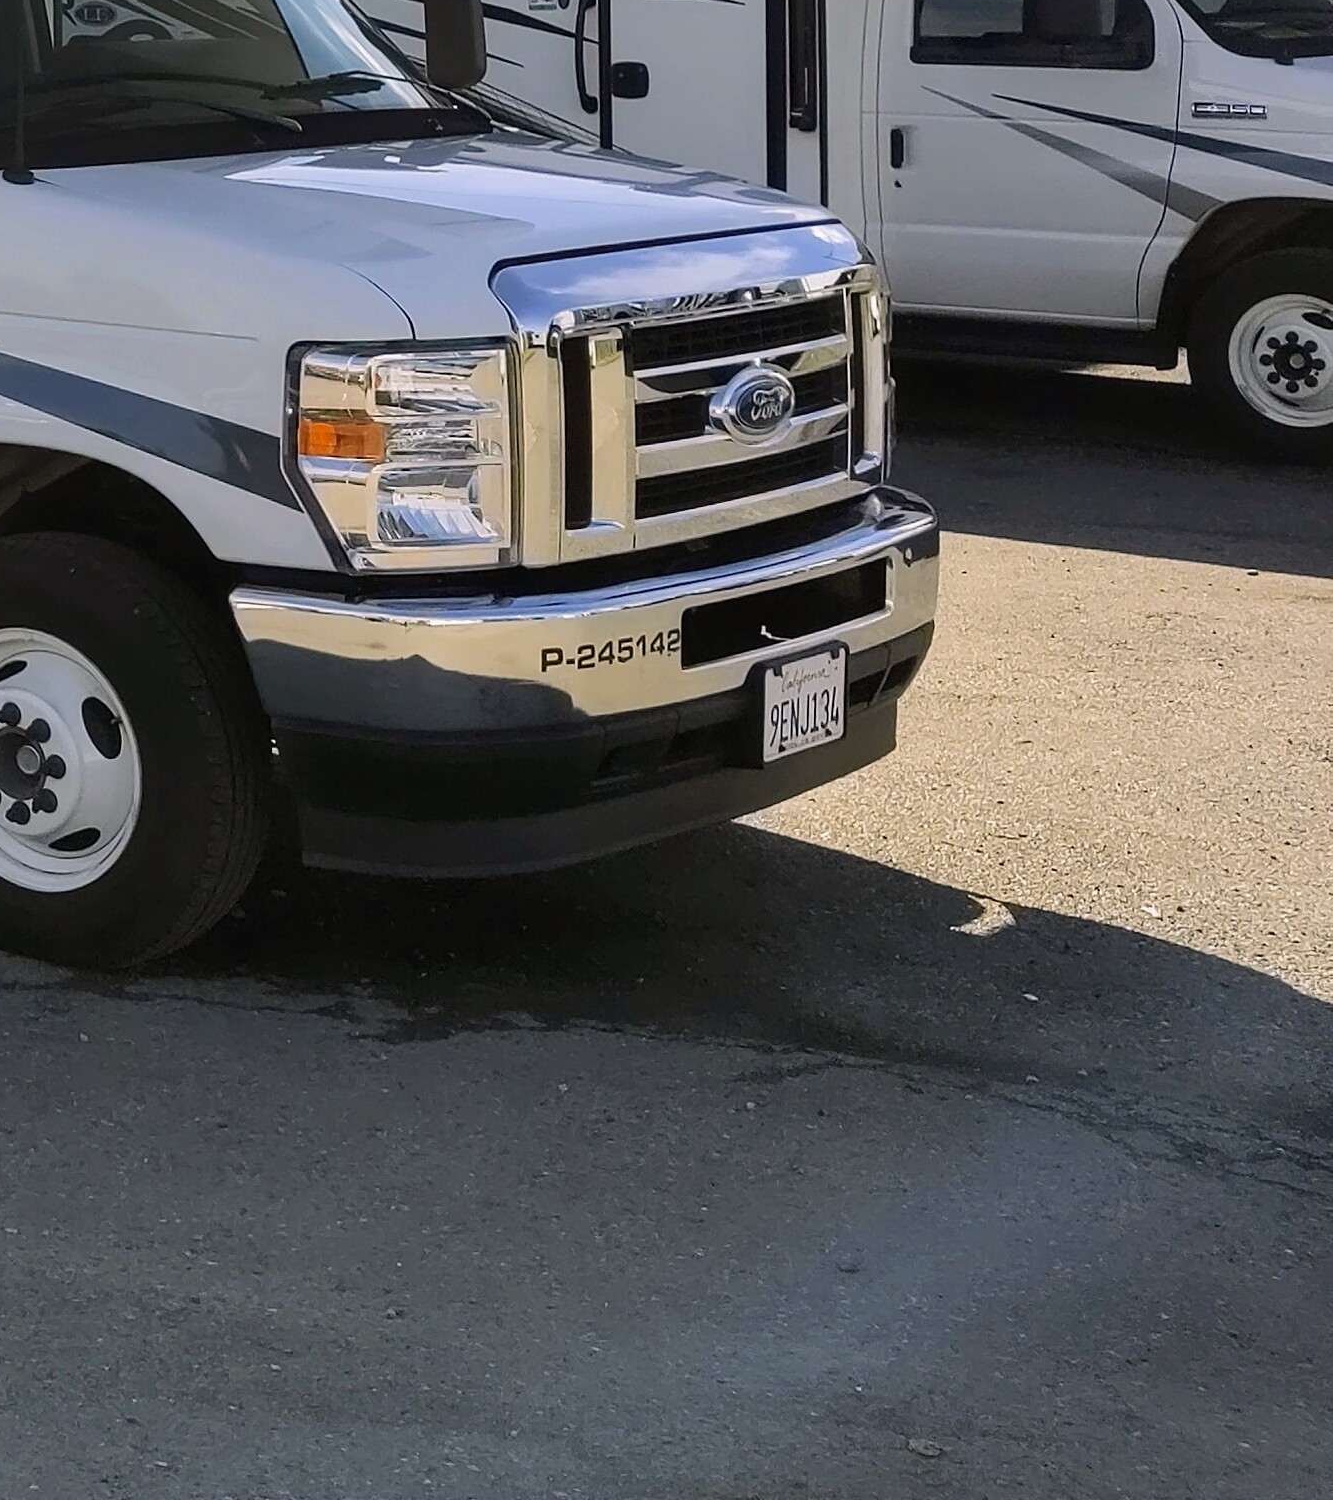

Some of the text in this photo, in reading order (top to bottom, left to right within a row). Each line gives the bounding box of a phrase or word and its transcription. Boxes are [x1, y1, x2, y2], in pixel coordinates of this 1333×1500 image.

[751, 386, 790, 421] Ford
[541, 628, 680, 672] P-245142
[782, 667, 831, 693] California
[770, 686, 839, 747] 9ENJ134
